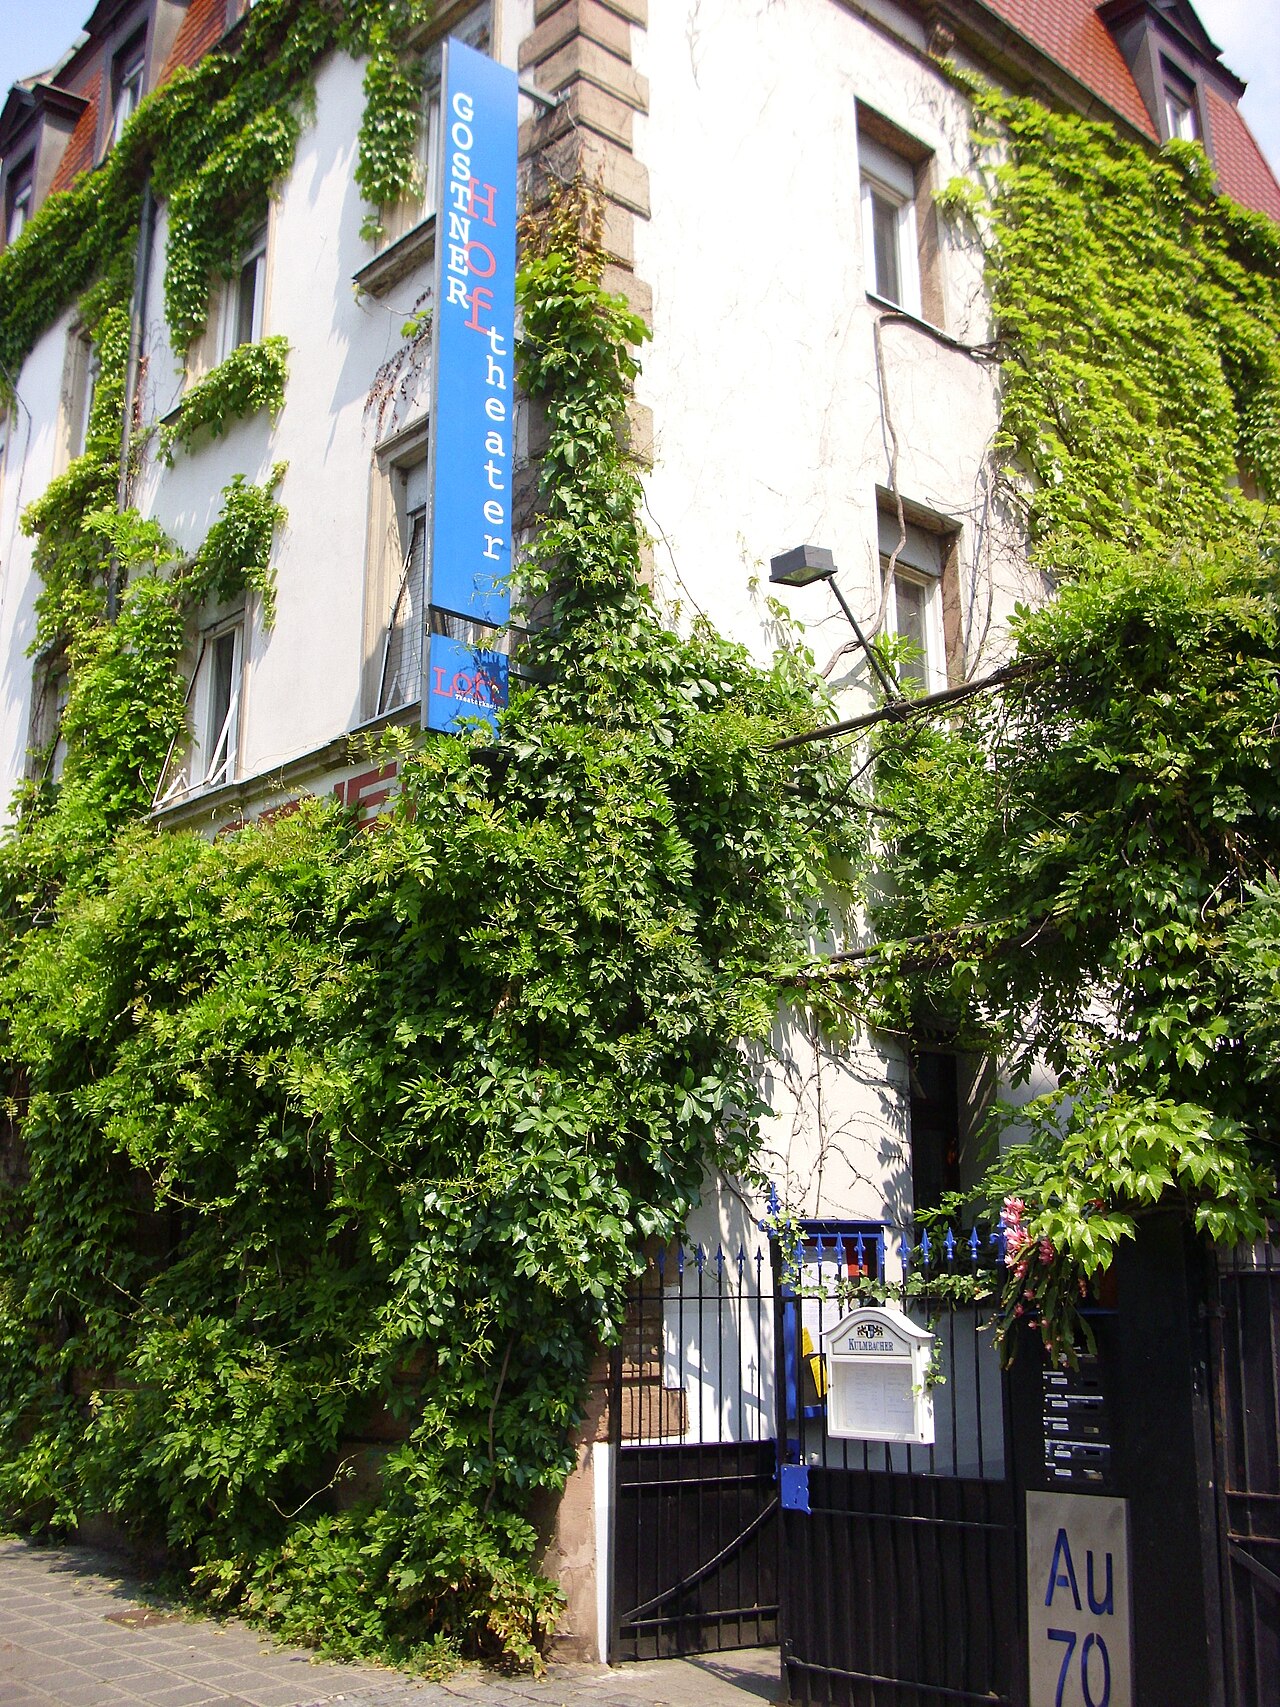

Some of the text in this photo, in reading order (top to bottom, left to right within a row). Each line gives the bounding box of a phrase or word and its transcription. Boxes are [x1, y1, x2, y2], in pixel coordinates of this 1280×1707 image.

[447, 93, 474, 309] GOSTNER
[848, 1338, 894, 1352] KULMBACHER
[1045, 1528, 1113, 1615] Au
[1047, 1629, 1111, 1707] 70
